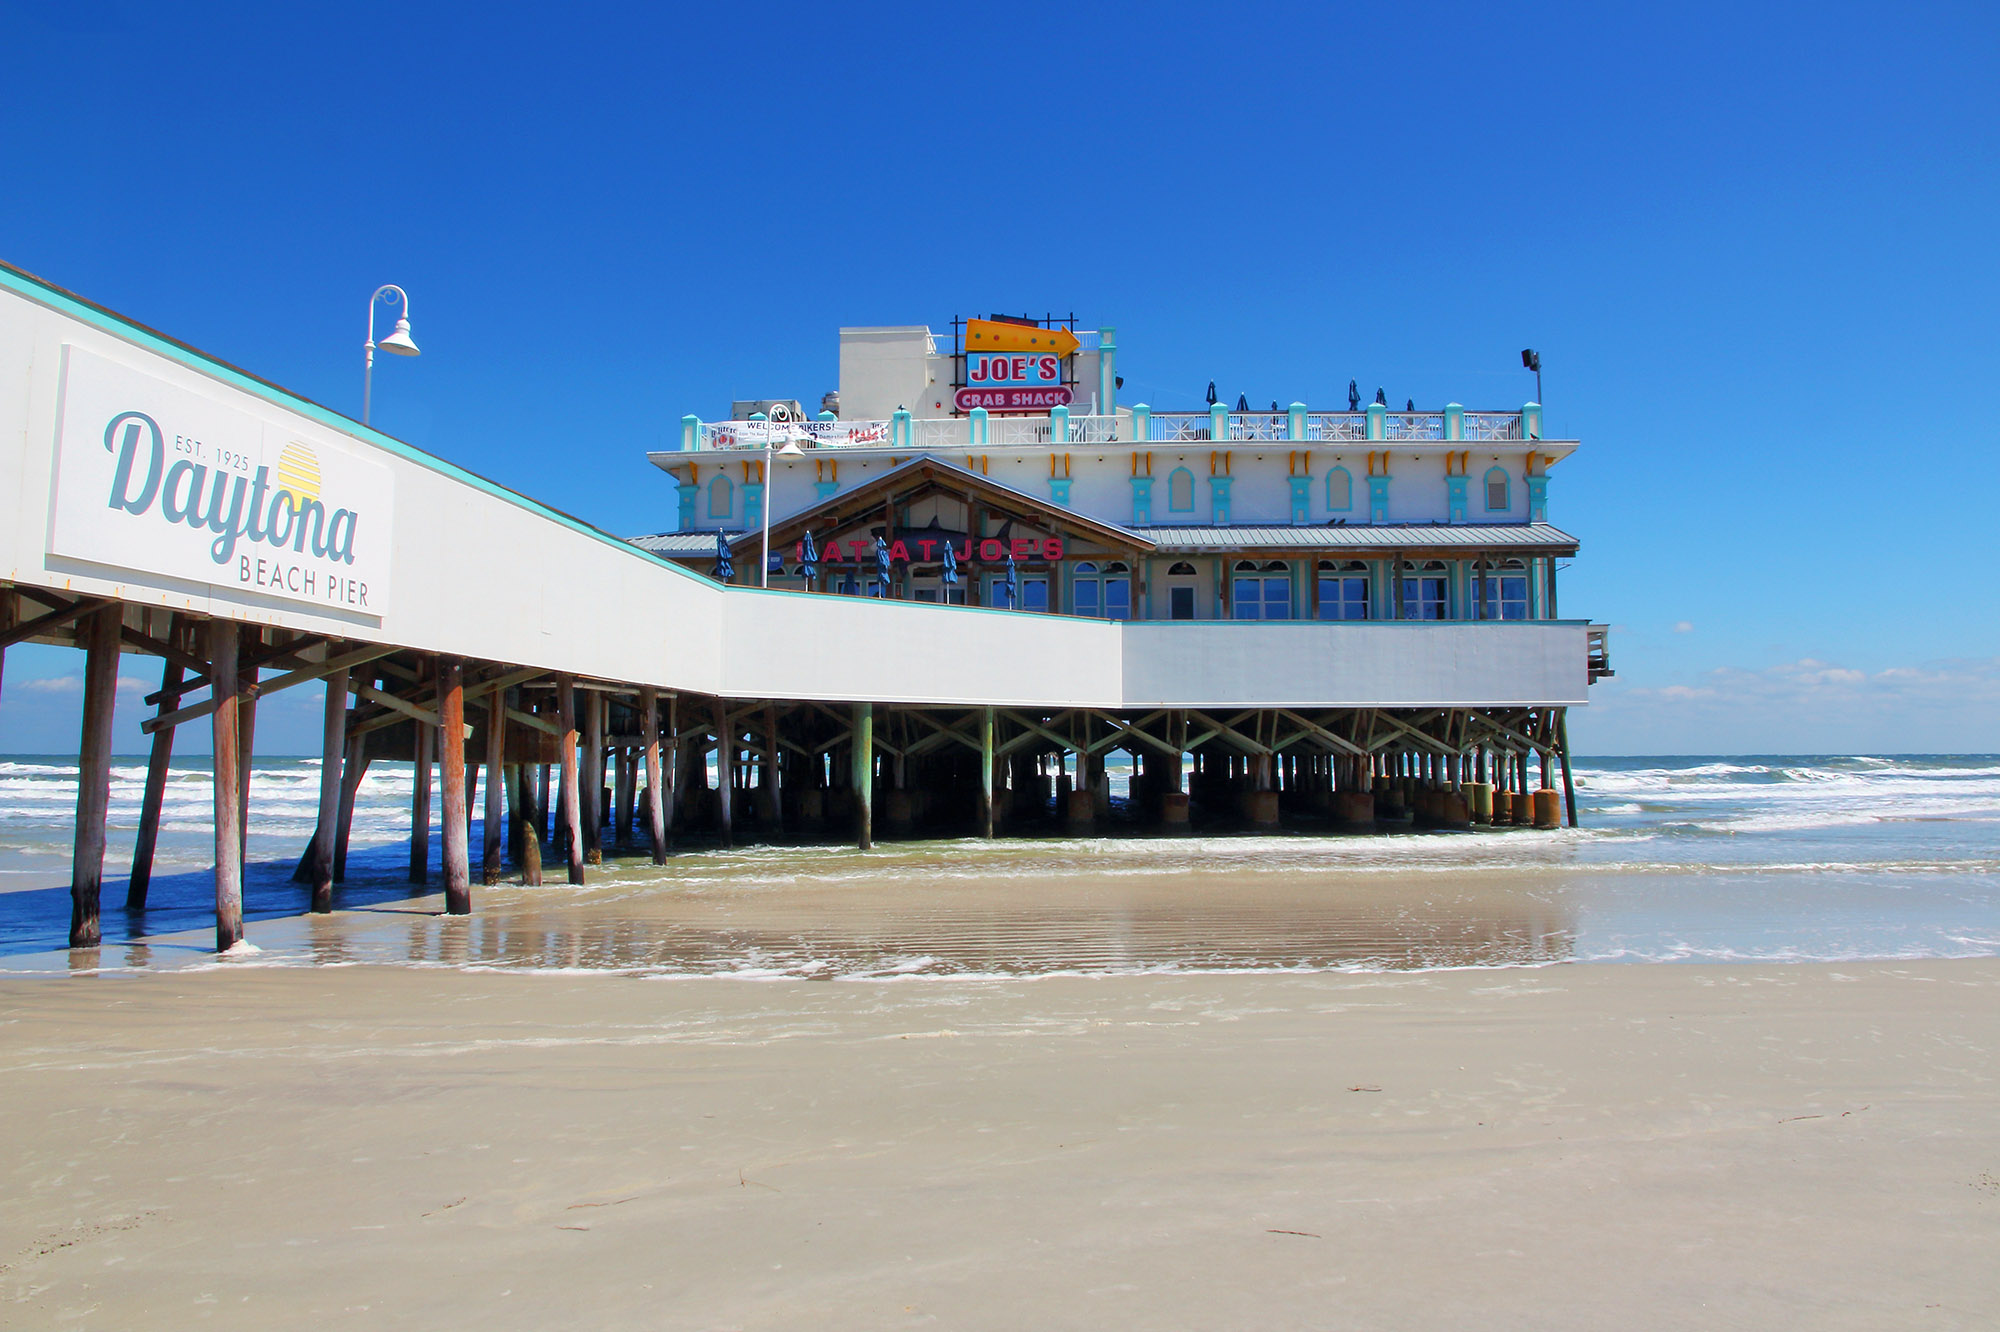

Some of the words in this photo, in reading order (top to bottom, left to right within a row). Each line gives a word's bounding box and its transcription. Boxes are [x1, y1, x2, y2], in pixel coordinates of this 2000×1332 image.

[969, 354, 1058, 382] JOE'S
[961, 393, 1005, 406] CRAB
[1011, 392, 1066, 406] SHACK
[175, 435, 206, 459] EST.
[217, 448, 249, 471] 1925
[104, 411, 359, 566] Daytona
[888, 539, 937, 562] AT
[954, 538, 1064, 561] JOE'S
[239, 555, 316, 596] BEACH
[328, 575, 369, 607] PIER
